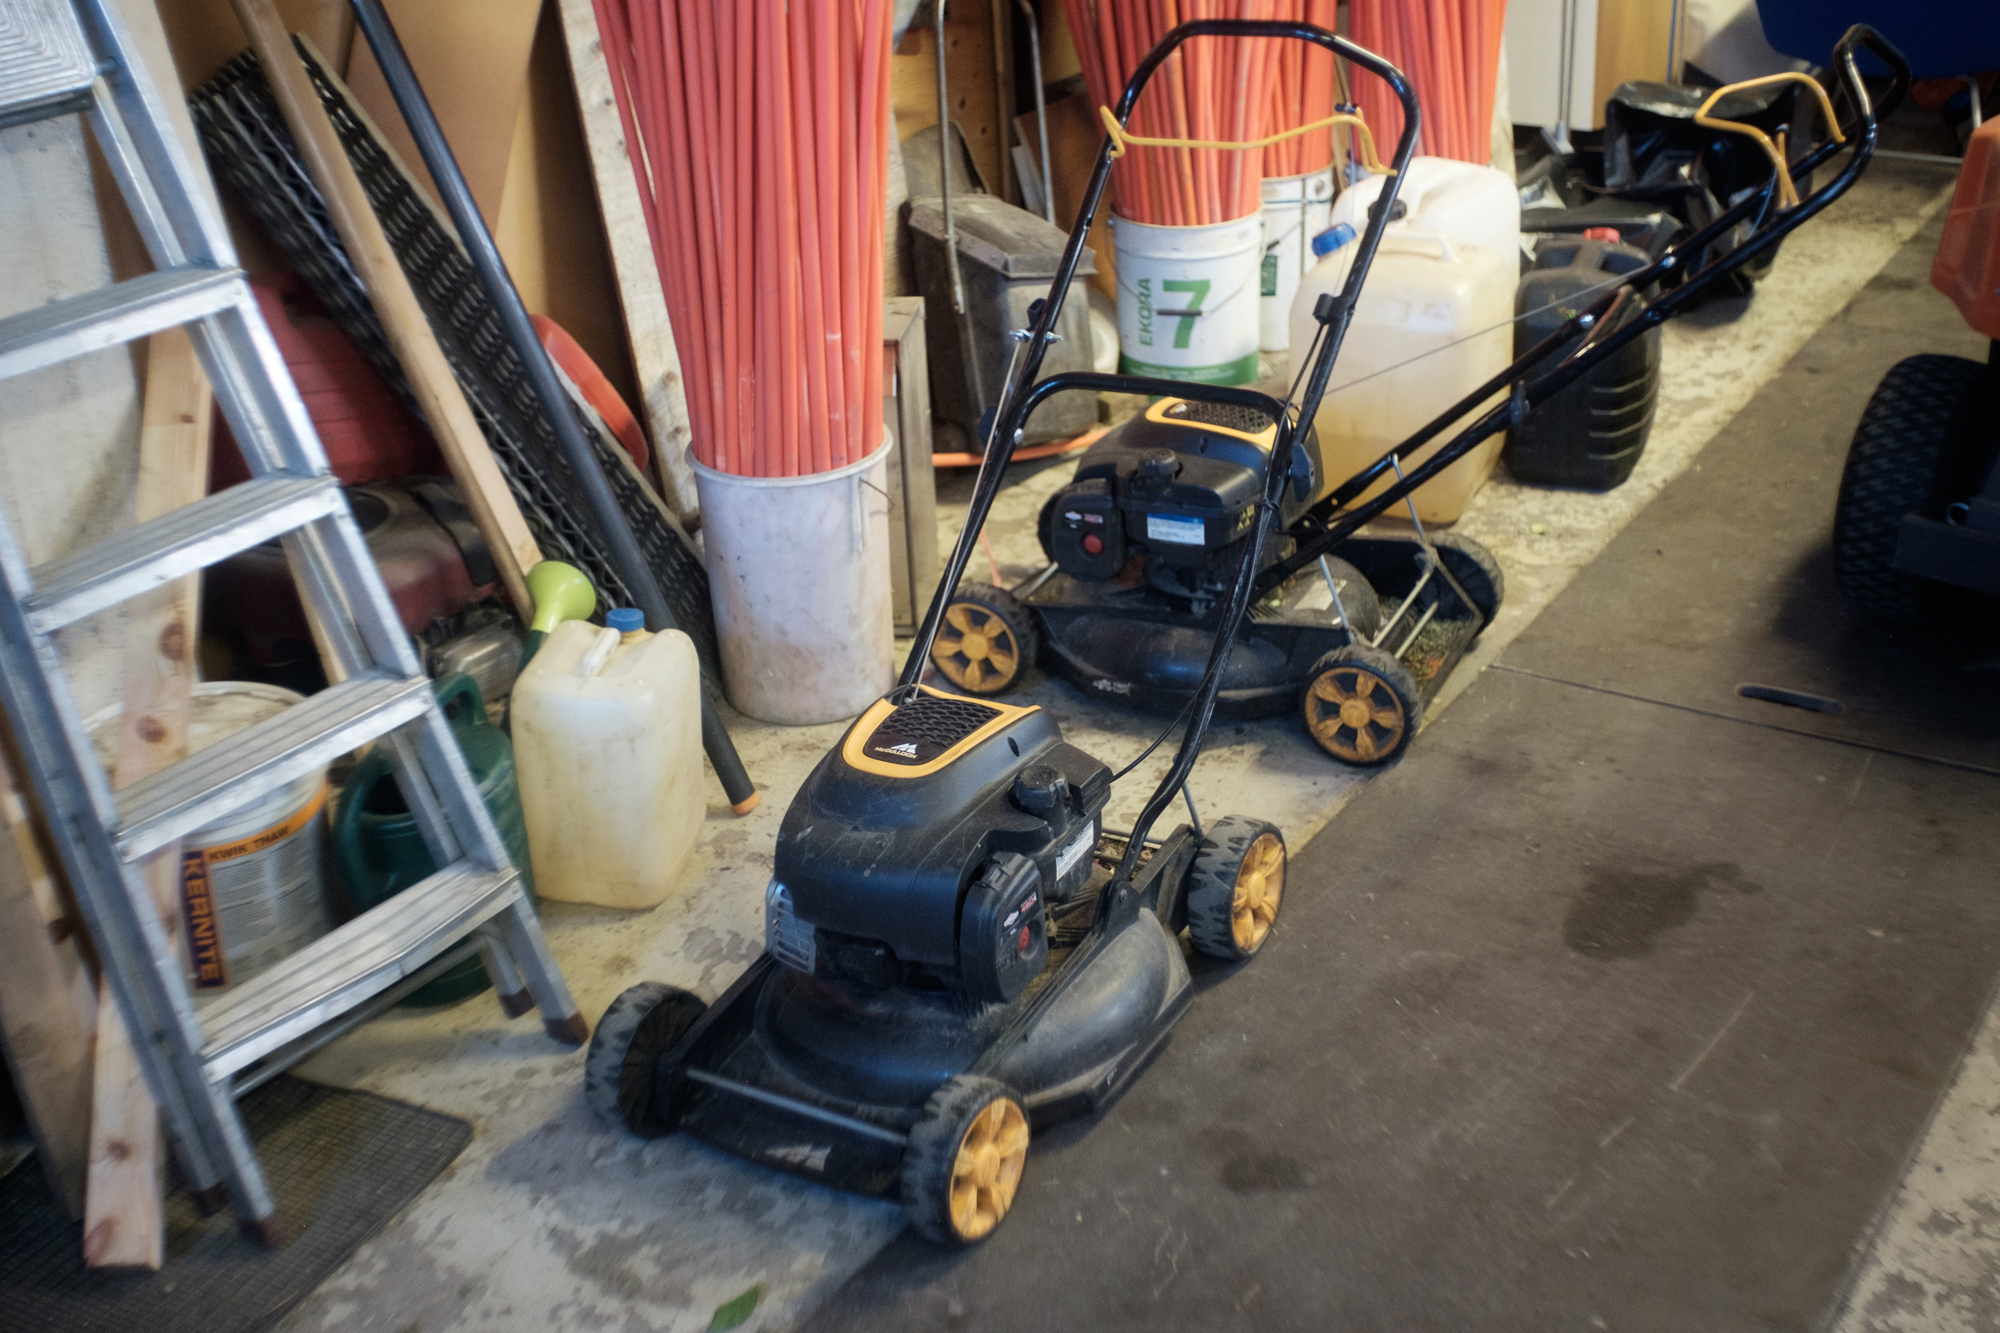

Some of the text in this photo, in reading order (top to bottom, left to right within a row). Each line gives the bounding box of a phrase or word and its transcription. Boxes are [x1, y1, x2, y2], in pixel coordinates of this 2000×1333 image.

[1138, 279, 1153, 347] EKORA
[1163, 280, 1211, 349] 7
[874, 746, 918, 759] McCULLOCH
[210, 826, 290, 861] KWIK THAW
[184, 858, 220, 980] KERNITE
